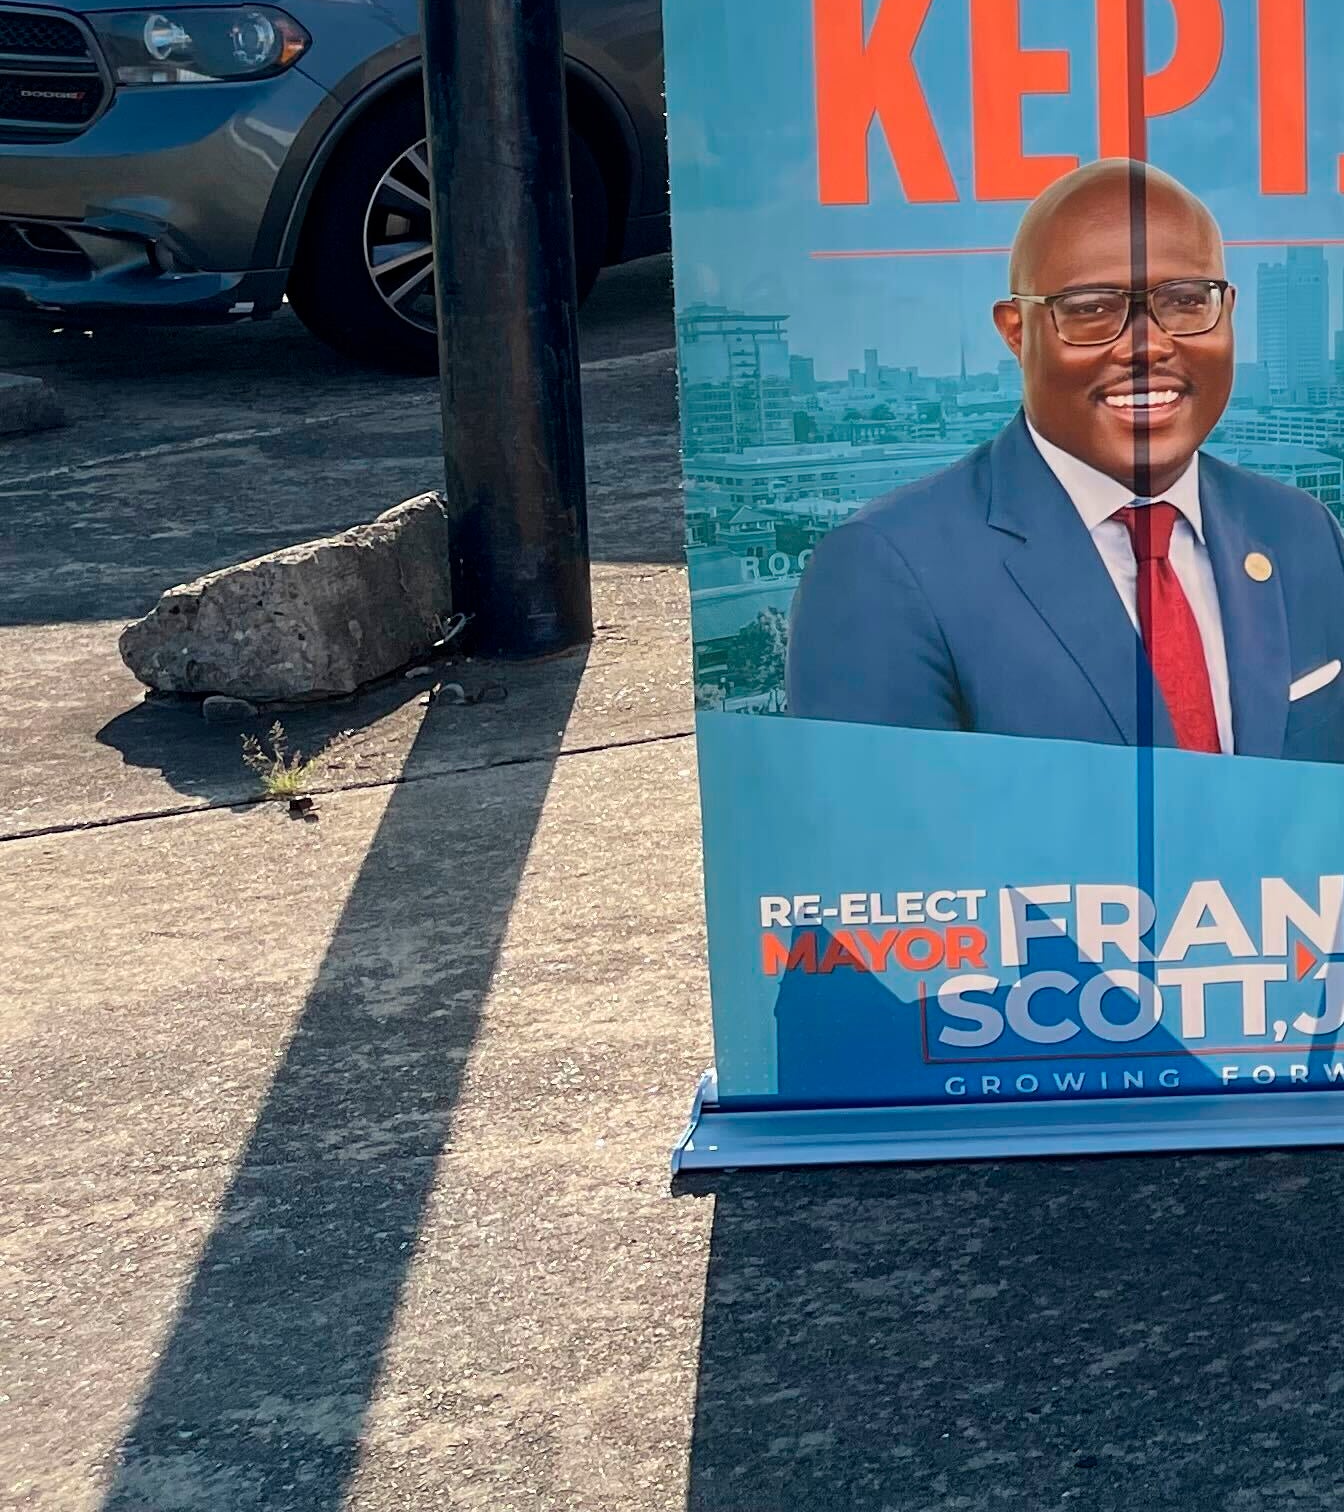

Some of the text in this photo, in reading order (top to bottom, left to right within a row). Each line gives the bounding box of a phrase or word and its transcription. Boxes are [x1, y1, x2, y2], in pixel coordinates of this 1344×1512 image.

[760, 887, 988, 929] RE-ELECT
[760, 923, 993, 978] MAYOR
[944, 1066, 1183, 1096] GROWING
